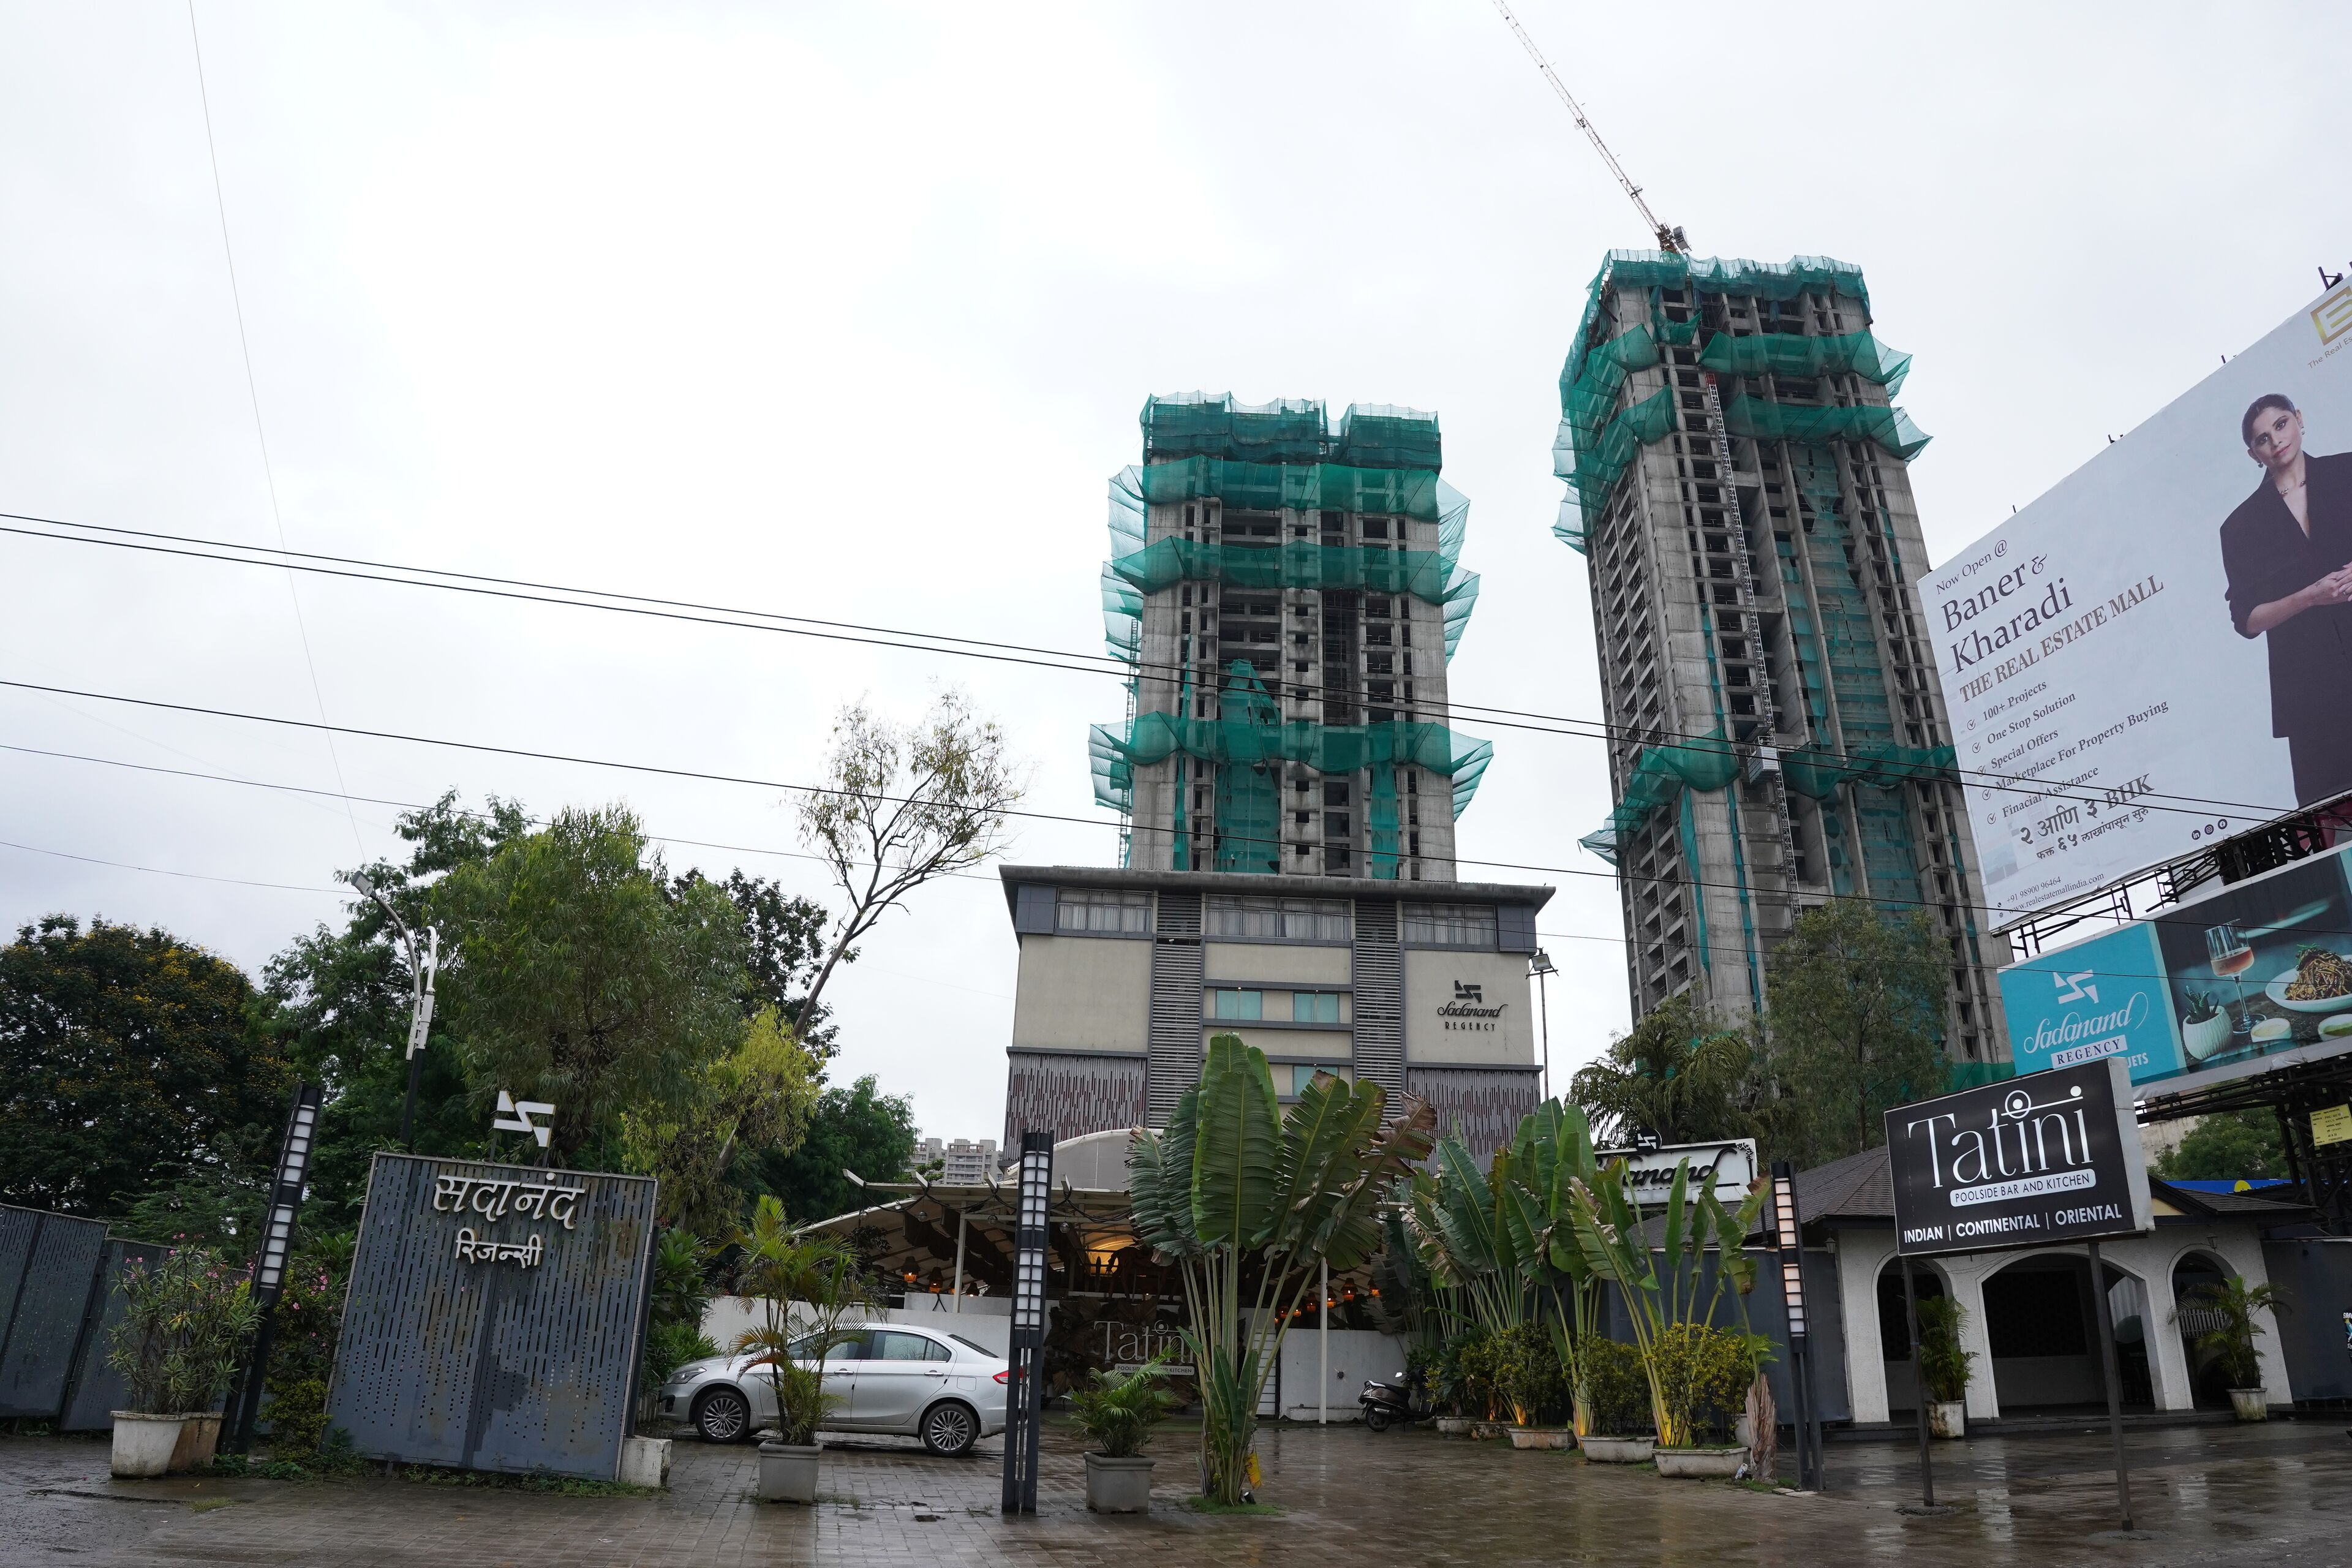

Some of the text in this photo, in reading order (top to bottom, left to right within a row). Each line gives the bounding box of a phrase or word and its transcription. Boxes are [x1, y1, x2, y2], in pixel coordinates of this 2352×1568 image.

[2307, 356, 2323, 369] The
[2324, 342, 2342, 358] Real
[1936, 540, 2008, 595] Now Open @
[1940, 553, 2048, 633] Baner &
[1950, 577, 2073, 674] Kharadi
[1959, 575, 2164, 703] THE REAL ESTATE MALL
[1983, 681, 2047, 721] 100+ Projects
[1987, 693, 2076, 744] One Stop Solution
[1991, 729, 2059, 769] Special Offers
[1994, 701, 2169, 792] Marketplace For Property Buying
[2001, 767, 2100, 818] Finacial Assistance
[2020, 773, 2155, 845] २ आणि ३ BHK
[2036, 846, 2054, 859] फक्त
[2058, 834, 2078, 851] ६५
[2081, 813, 2130, 842] लाखांपासून
[2007, 876, 2061, 903] +91 98900 96464
[2009, 873, 2105, 914] www.realestatemallindia.com
[1437, 1001, 1509, 1017] Sadanand
[1445, 1021, 1495, 1031] REGENCY
[2024, 992, 2149, 1054] Sadanand
[2056, 1039, 2120, 1065] REGENCY
[1907, 1085, 2094, 1188] Tatini
[433, 1172, 587, 1230] सदानंद
[1955, 1173, 2090, 1203] POOLSIDE BAR AND KITCHEN
[1904, 1204, 2122, 1243] INDIAN CONTINENTAL ORIENTAL
[455, 1227, 543, 1268] रिजन्सी
